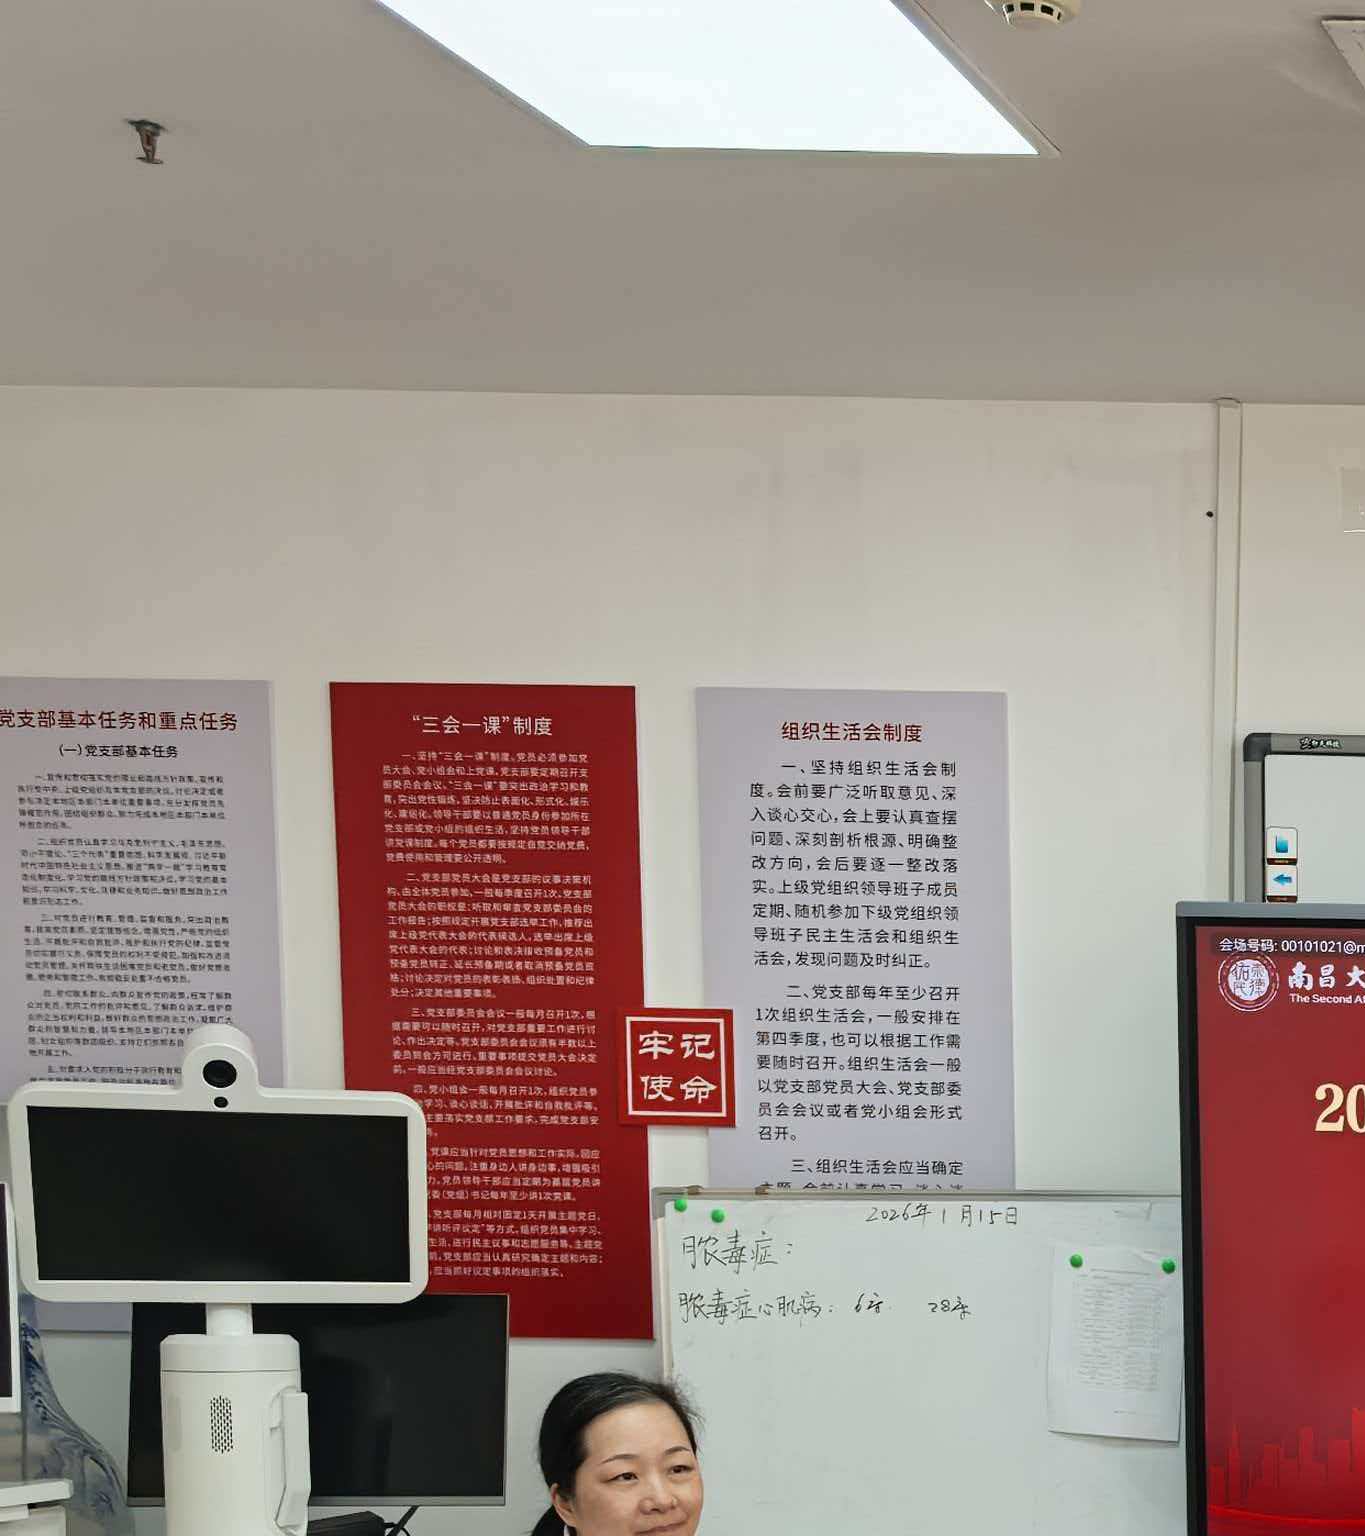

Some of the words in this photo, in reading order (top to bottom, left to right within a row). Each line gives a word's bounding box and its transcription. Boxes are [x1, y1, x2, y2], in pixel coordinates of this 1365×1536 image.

[412, 714, 552, 736] “三会一课”制度
[781, 720, 924, 742] 组织生活会制度
[780, 759, 955, 777] 一、坚持组织生活会制
[749, 781, 959, 801] 度。会前要广泛听取意见、深
[749, 806, 960, 825] 入谈心交心，会上要认真查摆
[750, 830, 960, 849] 问题、深刻剖析根源、明确整
[751, 854, 960, 873] 改方向，会后要逐一整改落
[751, 878, 957, 897] 实。上级党组织领导班子成员
[752, 903, 958, 921] 定期、随机参加下级党组织领
[752, 926, 960, 944] 导班子民主生活会和组织生
[753, 950, 930, 968] 活会，发现问题及时纠正。
[784, 983, 960, 1001] 二、党支部每年至少召开
[1289, 993, 1310, 1004] The
[1312, 994, 1352, 1005] Second
[754, 1006, 960, 1025] 1次组织生活会，一般安排在
[638, 1030, 716, 1060] 牢记
[754, 1030, 960, 1049] 第四季度，也可以根据工作需
[756, 1054, 961, 1072] 要随时召开。组织生活会一般
[640, 1075, 718, 1104] 使命
[757, 1077, 961, 1096] 以党支部党员大会、党支部委
[757, 1101, 962, 1120] 员会会议或者党小组会形式
[757, 1125, 796, 1141] 召开。
[790, 1158, 963, 1176] 三、组织生活会应当确定
